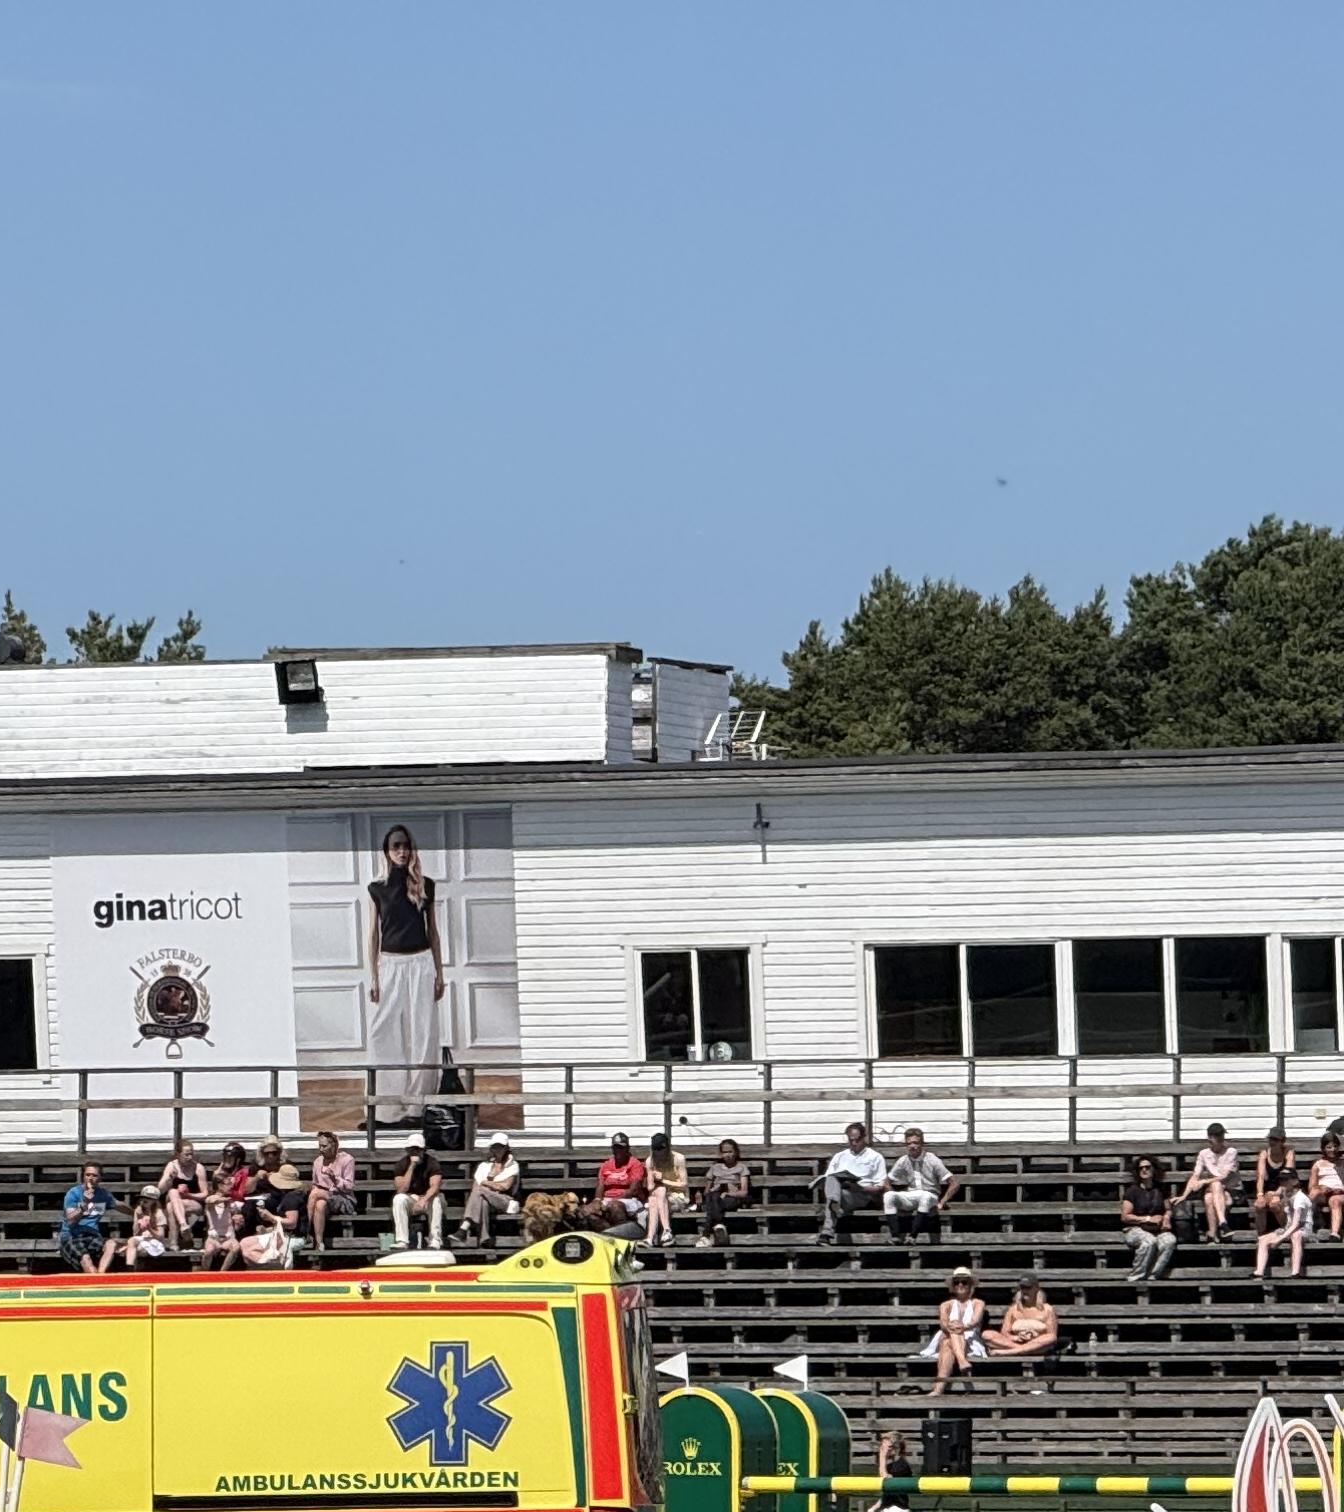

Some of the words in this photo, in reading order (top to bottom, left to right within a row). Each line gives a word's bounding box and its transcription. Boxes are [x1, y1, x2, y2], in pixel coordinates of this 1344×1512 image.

[93, 890, 242, 928] ginatricot
[136, 948, 203, 970] FALSTERBO
[215, 1469, 519, 1492] AMBULANSSJUKVÅRDEN
